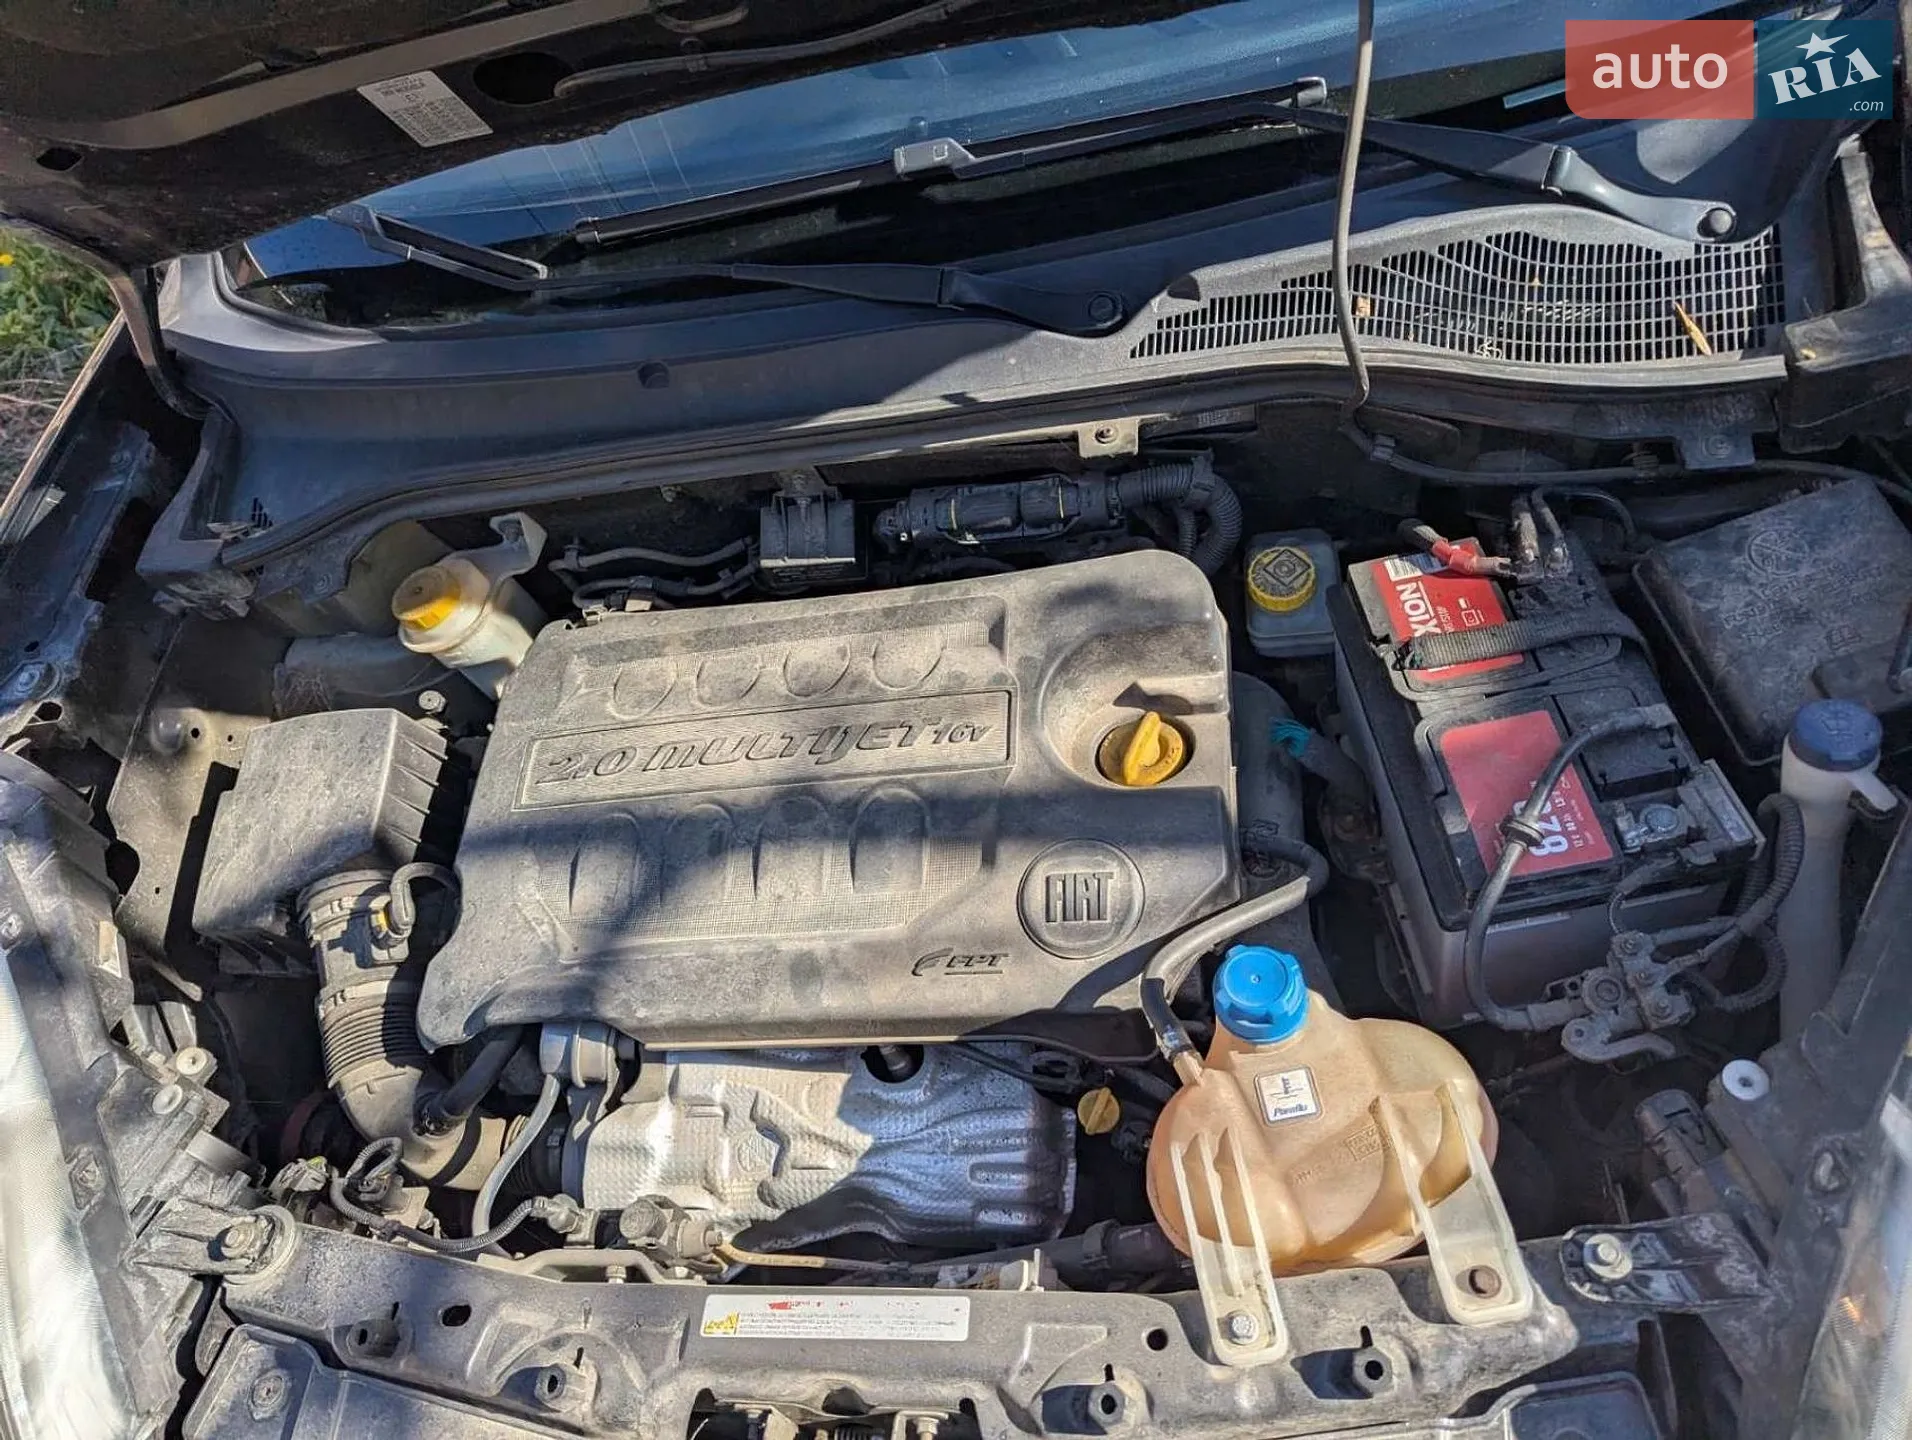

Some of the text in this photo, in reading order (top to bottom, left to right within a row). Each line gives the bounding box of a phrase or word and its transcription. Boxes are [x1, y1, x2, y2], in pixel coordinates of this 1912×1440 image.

[535, 746, 637, 785] 2.0
[1045, 871, 1115, 923] FIAT
[945, 952, 1010, 969] FPT
